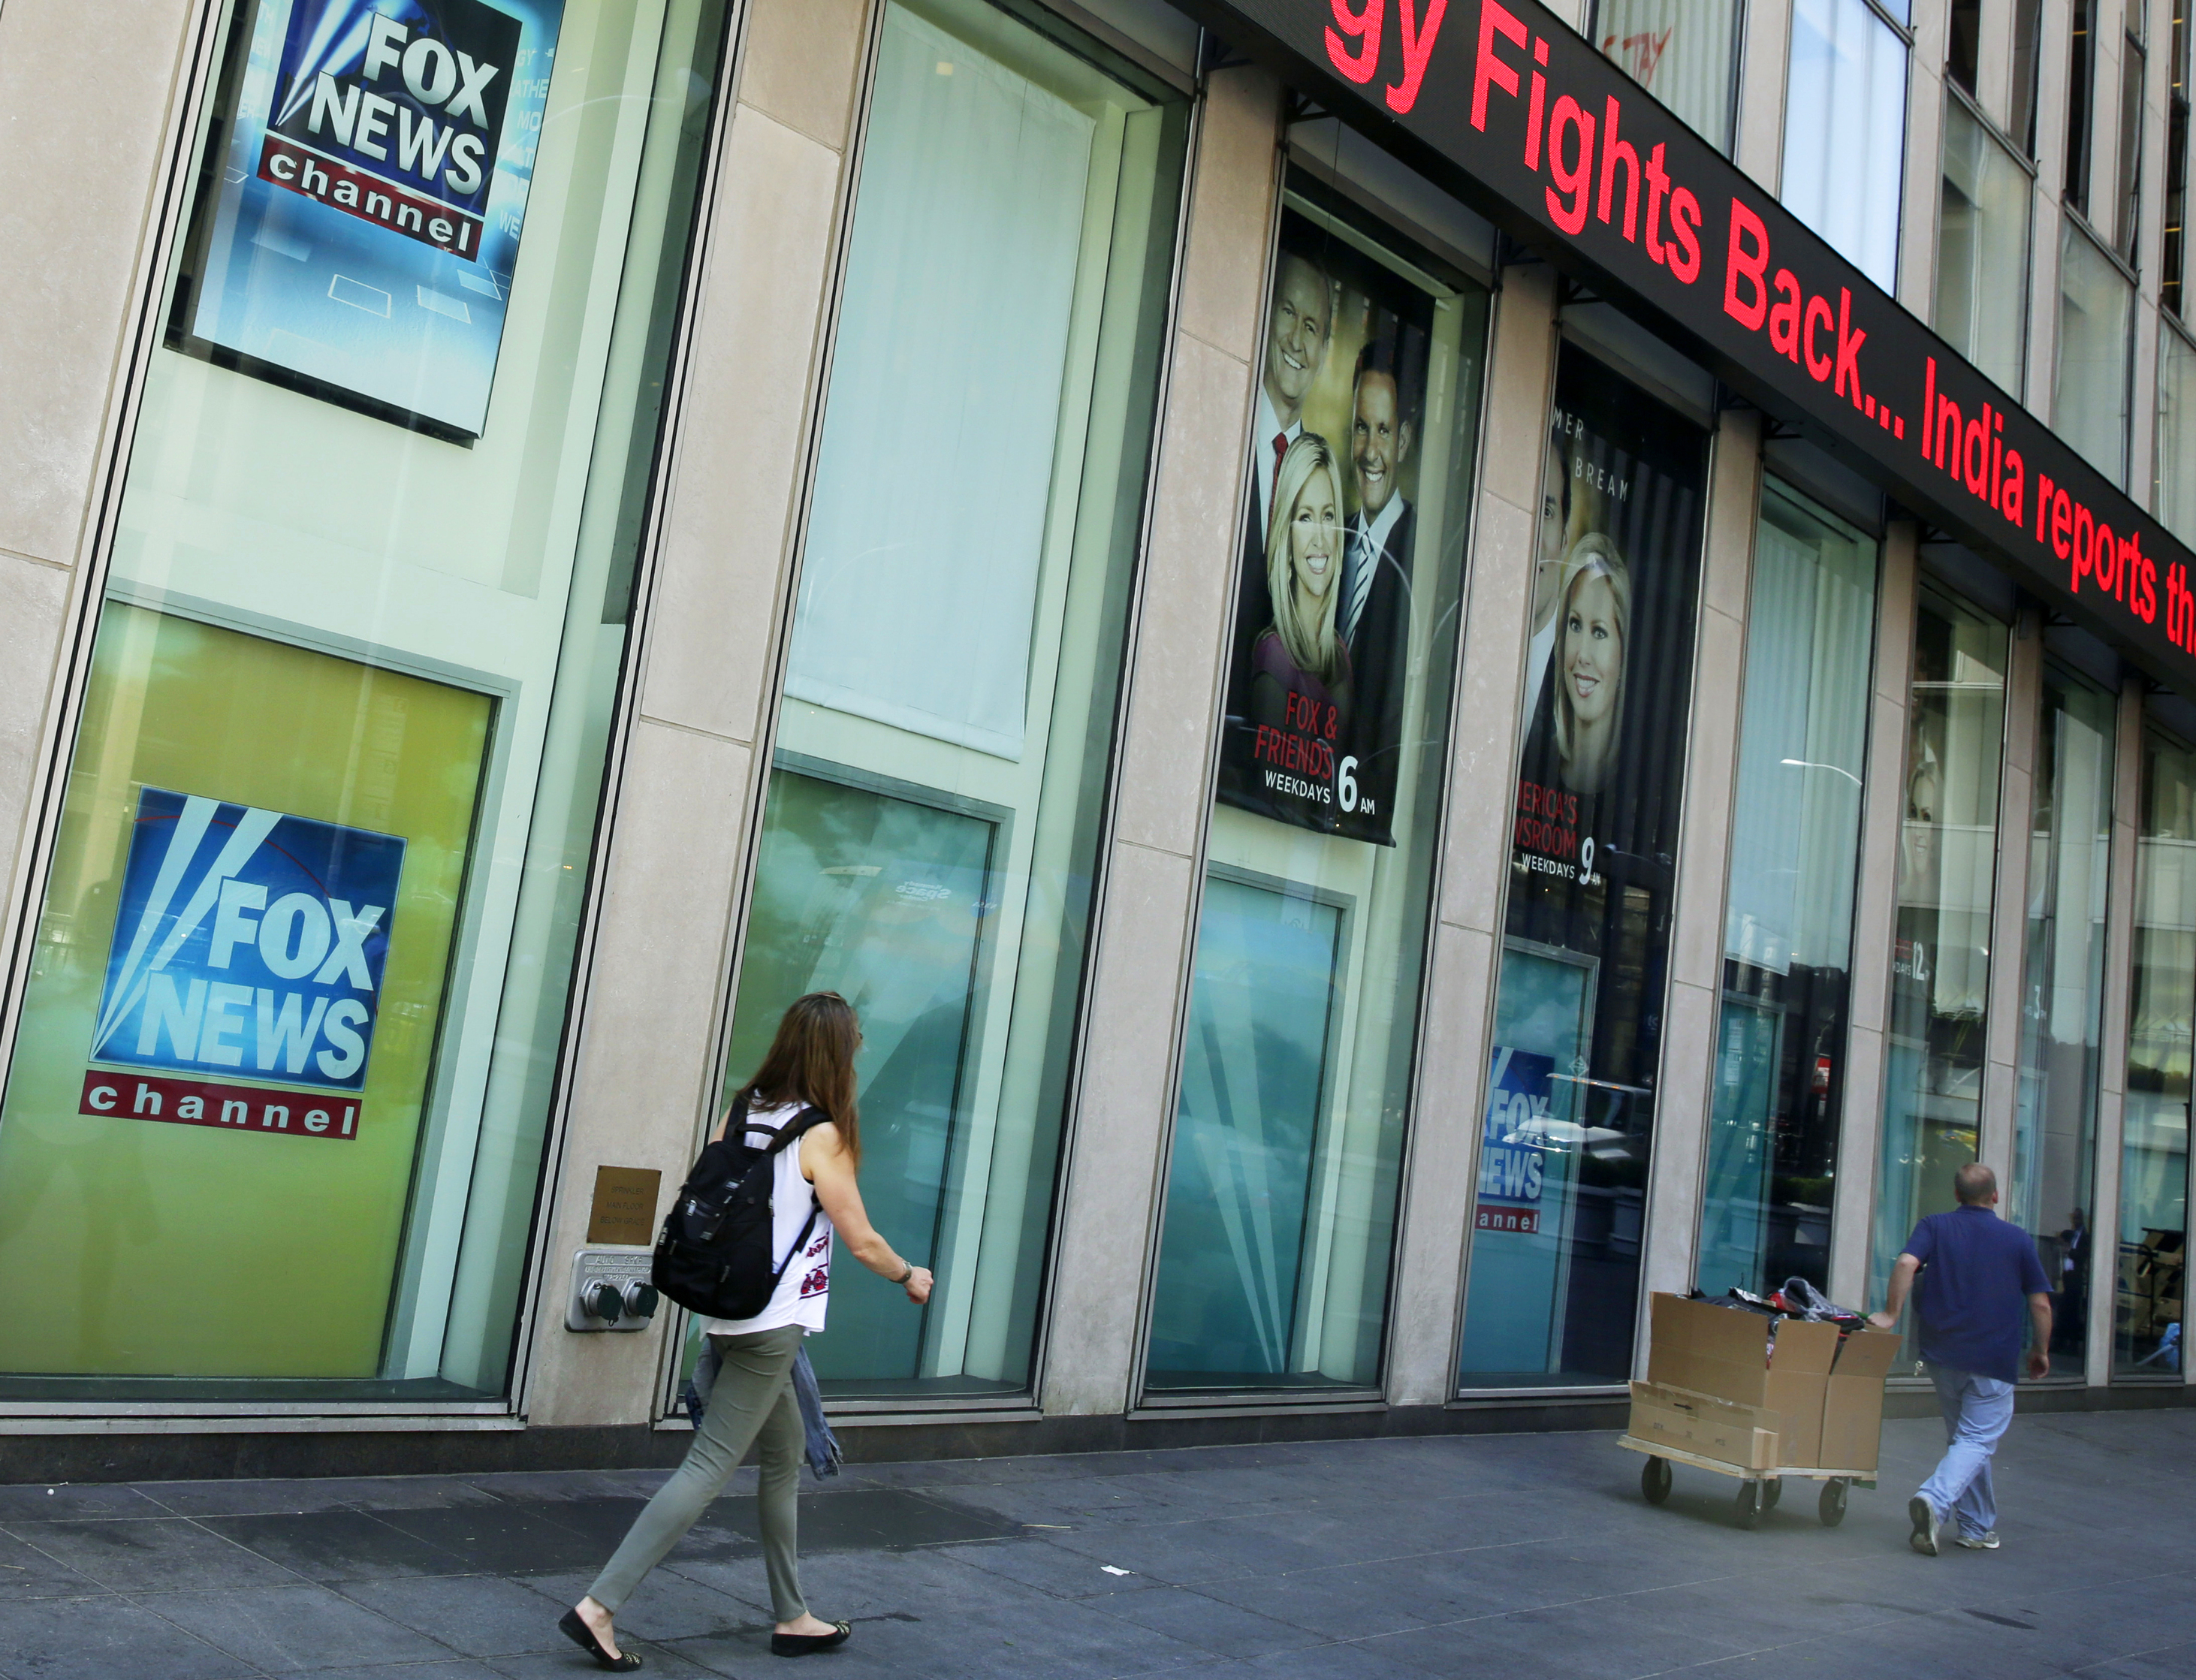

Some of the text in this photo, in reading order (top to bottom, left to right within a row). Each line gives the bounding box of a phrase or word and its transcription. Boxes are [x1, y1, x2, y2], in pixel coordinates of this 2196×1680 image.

[363, 11, 499, 130] FOX
[307, 71, 485, 195] NEWS
[269, 154, 471, 252] channel
[1325, 0, 1447, 114] gy
[1471, 0, 1702, 284] Fights
[1724, 197, 1905, 440] Back...
[1921, 356, 2026, 527] India
[2036, 473, 2157, 624] reports
[1575, 457, 1628, 502] BREAM
[1285, 692, 1338, 740] FOX &
[1254, 725, 1335, 780] FRIENDS
[1265, 756, 1375, 815] WEEKDAYS 6 AM
[1522, 853, 1576, 879] WEEKDAYS
[1579, 837, 1594, 885] 9
[207, 879, 386, 991] FOX
[1912, 942, 1925, 981] 12
[136, 971, 370, 1079] NEWS
[89, 1083, 355, 1135] channel
[1489, 1089, 1549, 1146] FOX
[611, 1187, 644, 1195] SPRINKLER
[1480, 1211, 1539, 1230] annel
